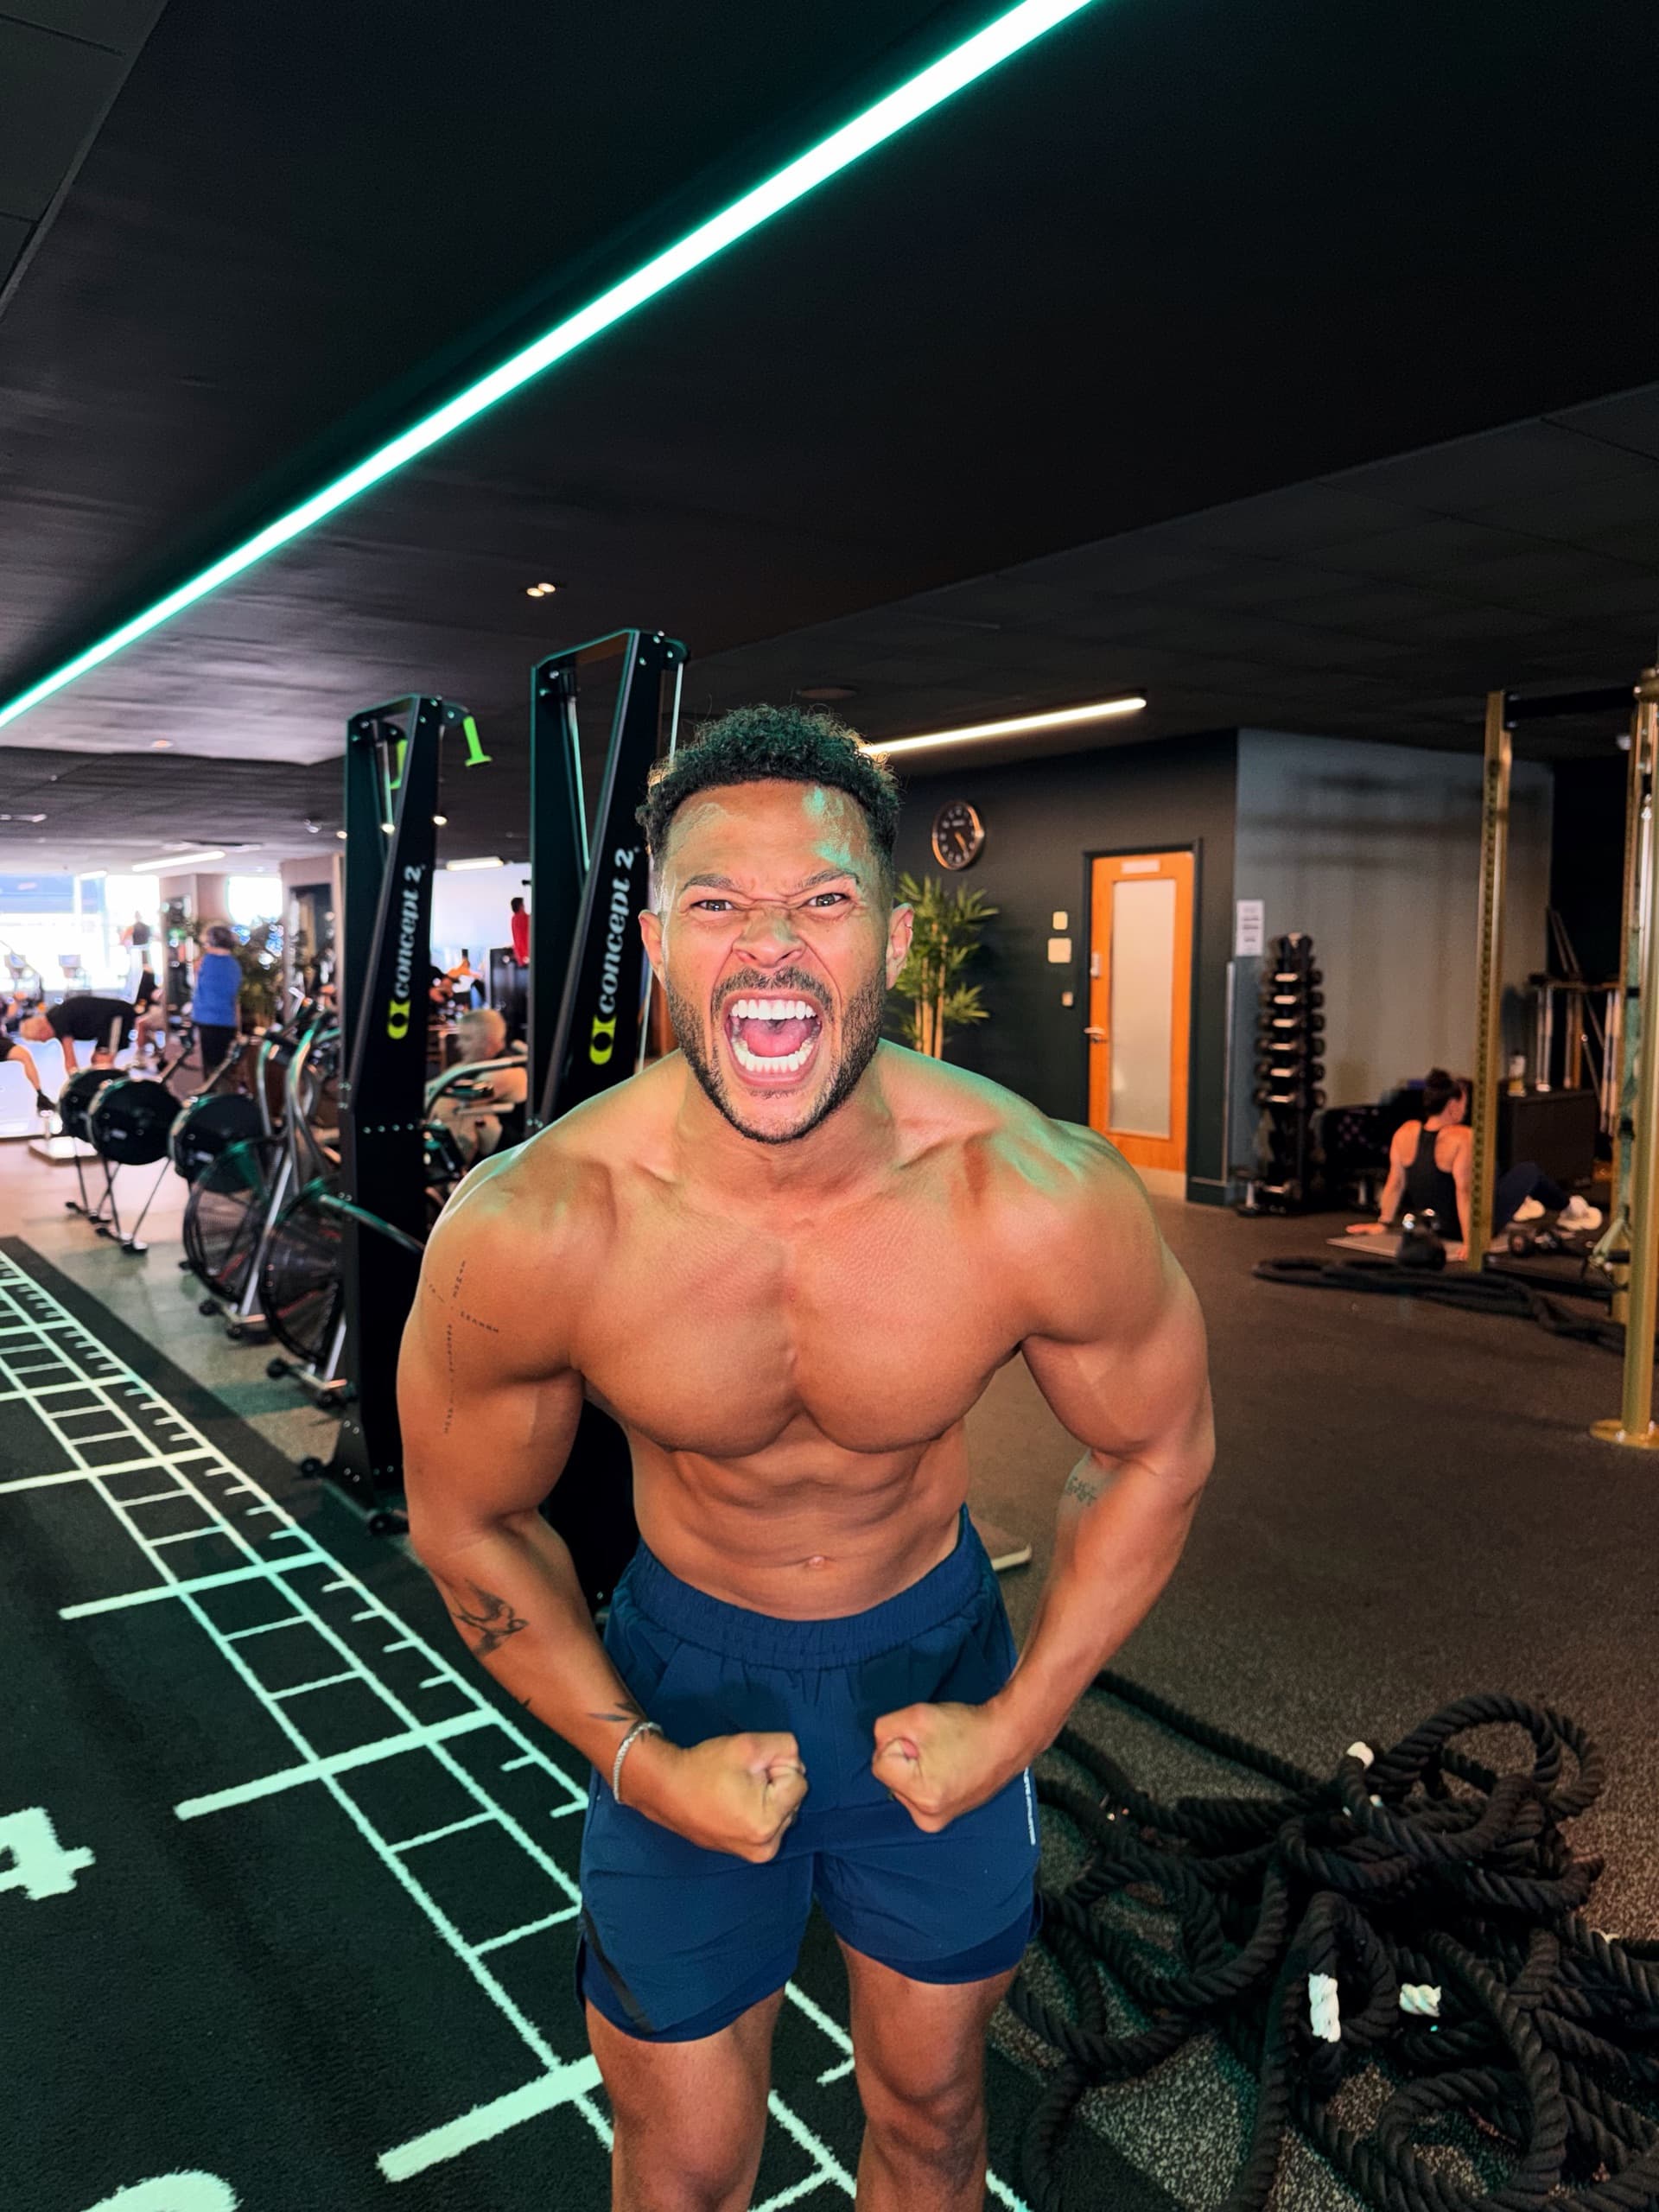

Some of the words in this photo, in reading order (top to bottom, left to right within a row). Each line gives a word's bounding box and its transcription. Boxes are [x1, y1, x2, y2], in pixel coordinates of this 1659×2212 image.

[404, 865, 423, 883] 2
[614, 848, 635, 870] 2
[394, 887, 419, 999] concept
[599, 876, 631, 1014] concept
